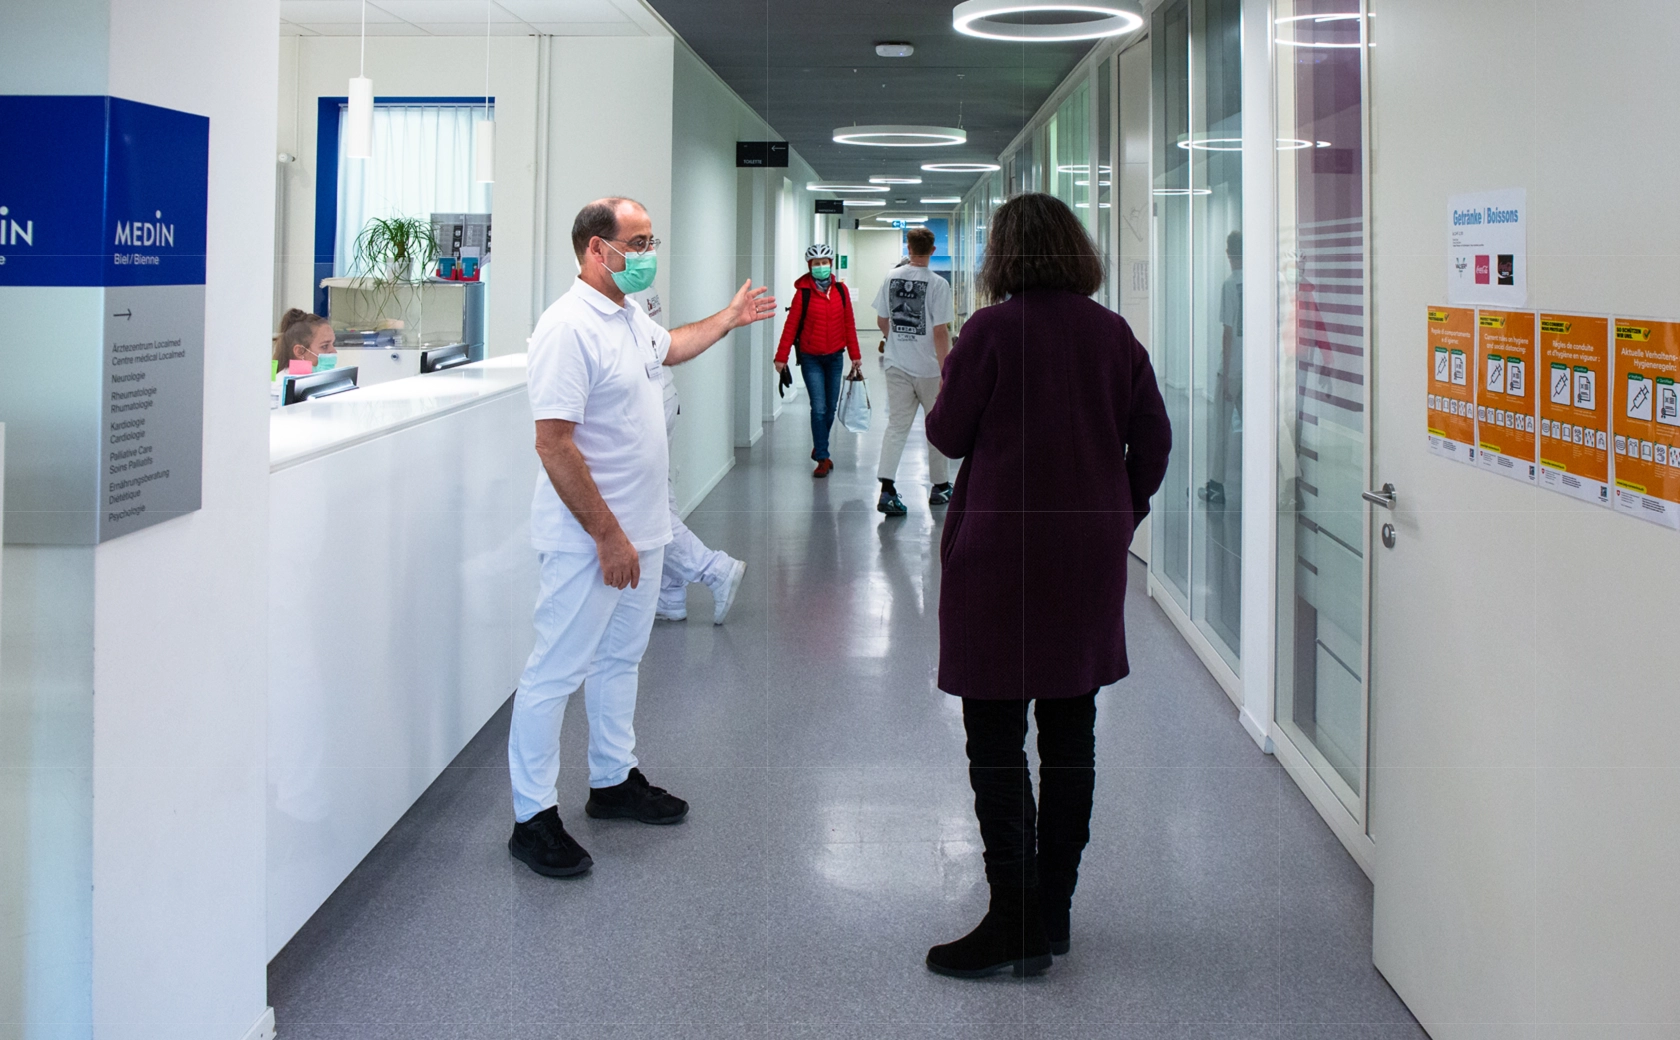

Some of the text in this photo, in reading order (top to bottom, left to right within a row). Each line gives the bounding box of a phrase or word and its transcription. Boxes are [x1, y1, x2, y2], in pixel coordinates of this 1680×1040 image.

[1453, 208, 1482, 226] Getränke
[1487, 207, 1519, 224] Boissons
[114, 253, 160, 265] Biel/Bienne
[112, 338, 181, 353] Ärztezentrum Localmed
[1573, 343, 1594, 352] conduite
[1621, 348, 1644, 357] Aktuelle
[112, 356, 134, 366] Centre
[159, 349, 185, 361] Localmed
[111, 372, 145, 383] Neurologie
[111, 386, 157, 401] Rheumatologie
[111, 400, 153, 413] Rhumatologie
[110, 418, 145, 430] Kardiologie
[110, 430, 145, 444] Cardiologie
[110, 446, 152, 461] Palliative Care
[110, 464, 127, 474] Soins
[110, 470, 169, 492] Ernährungsberatung
[108, 505, 145, 522] Psychologie
